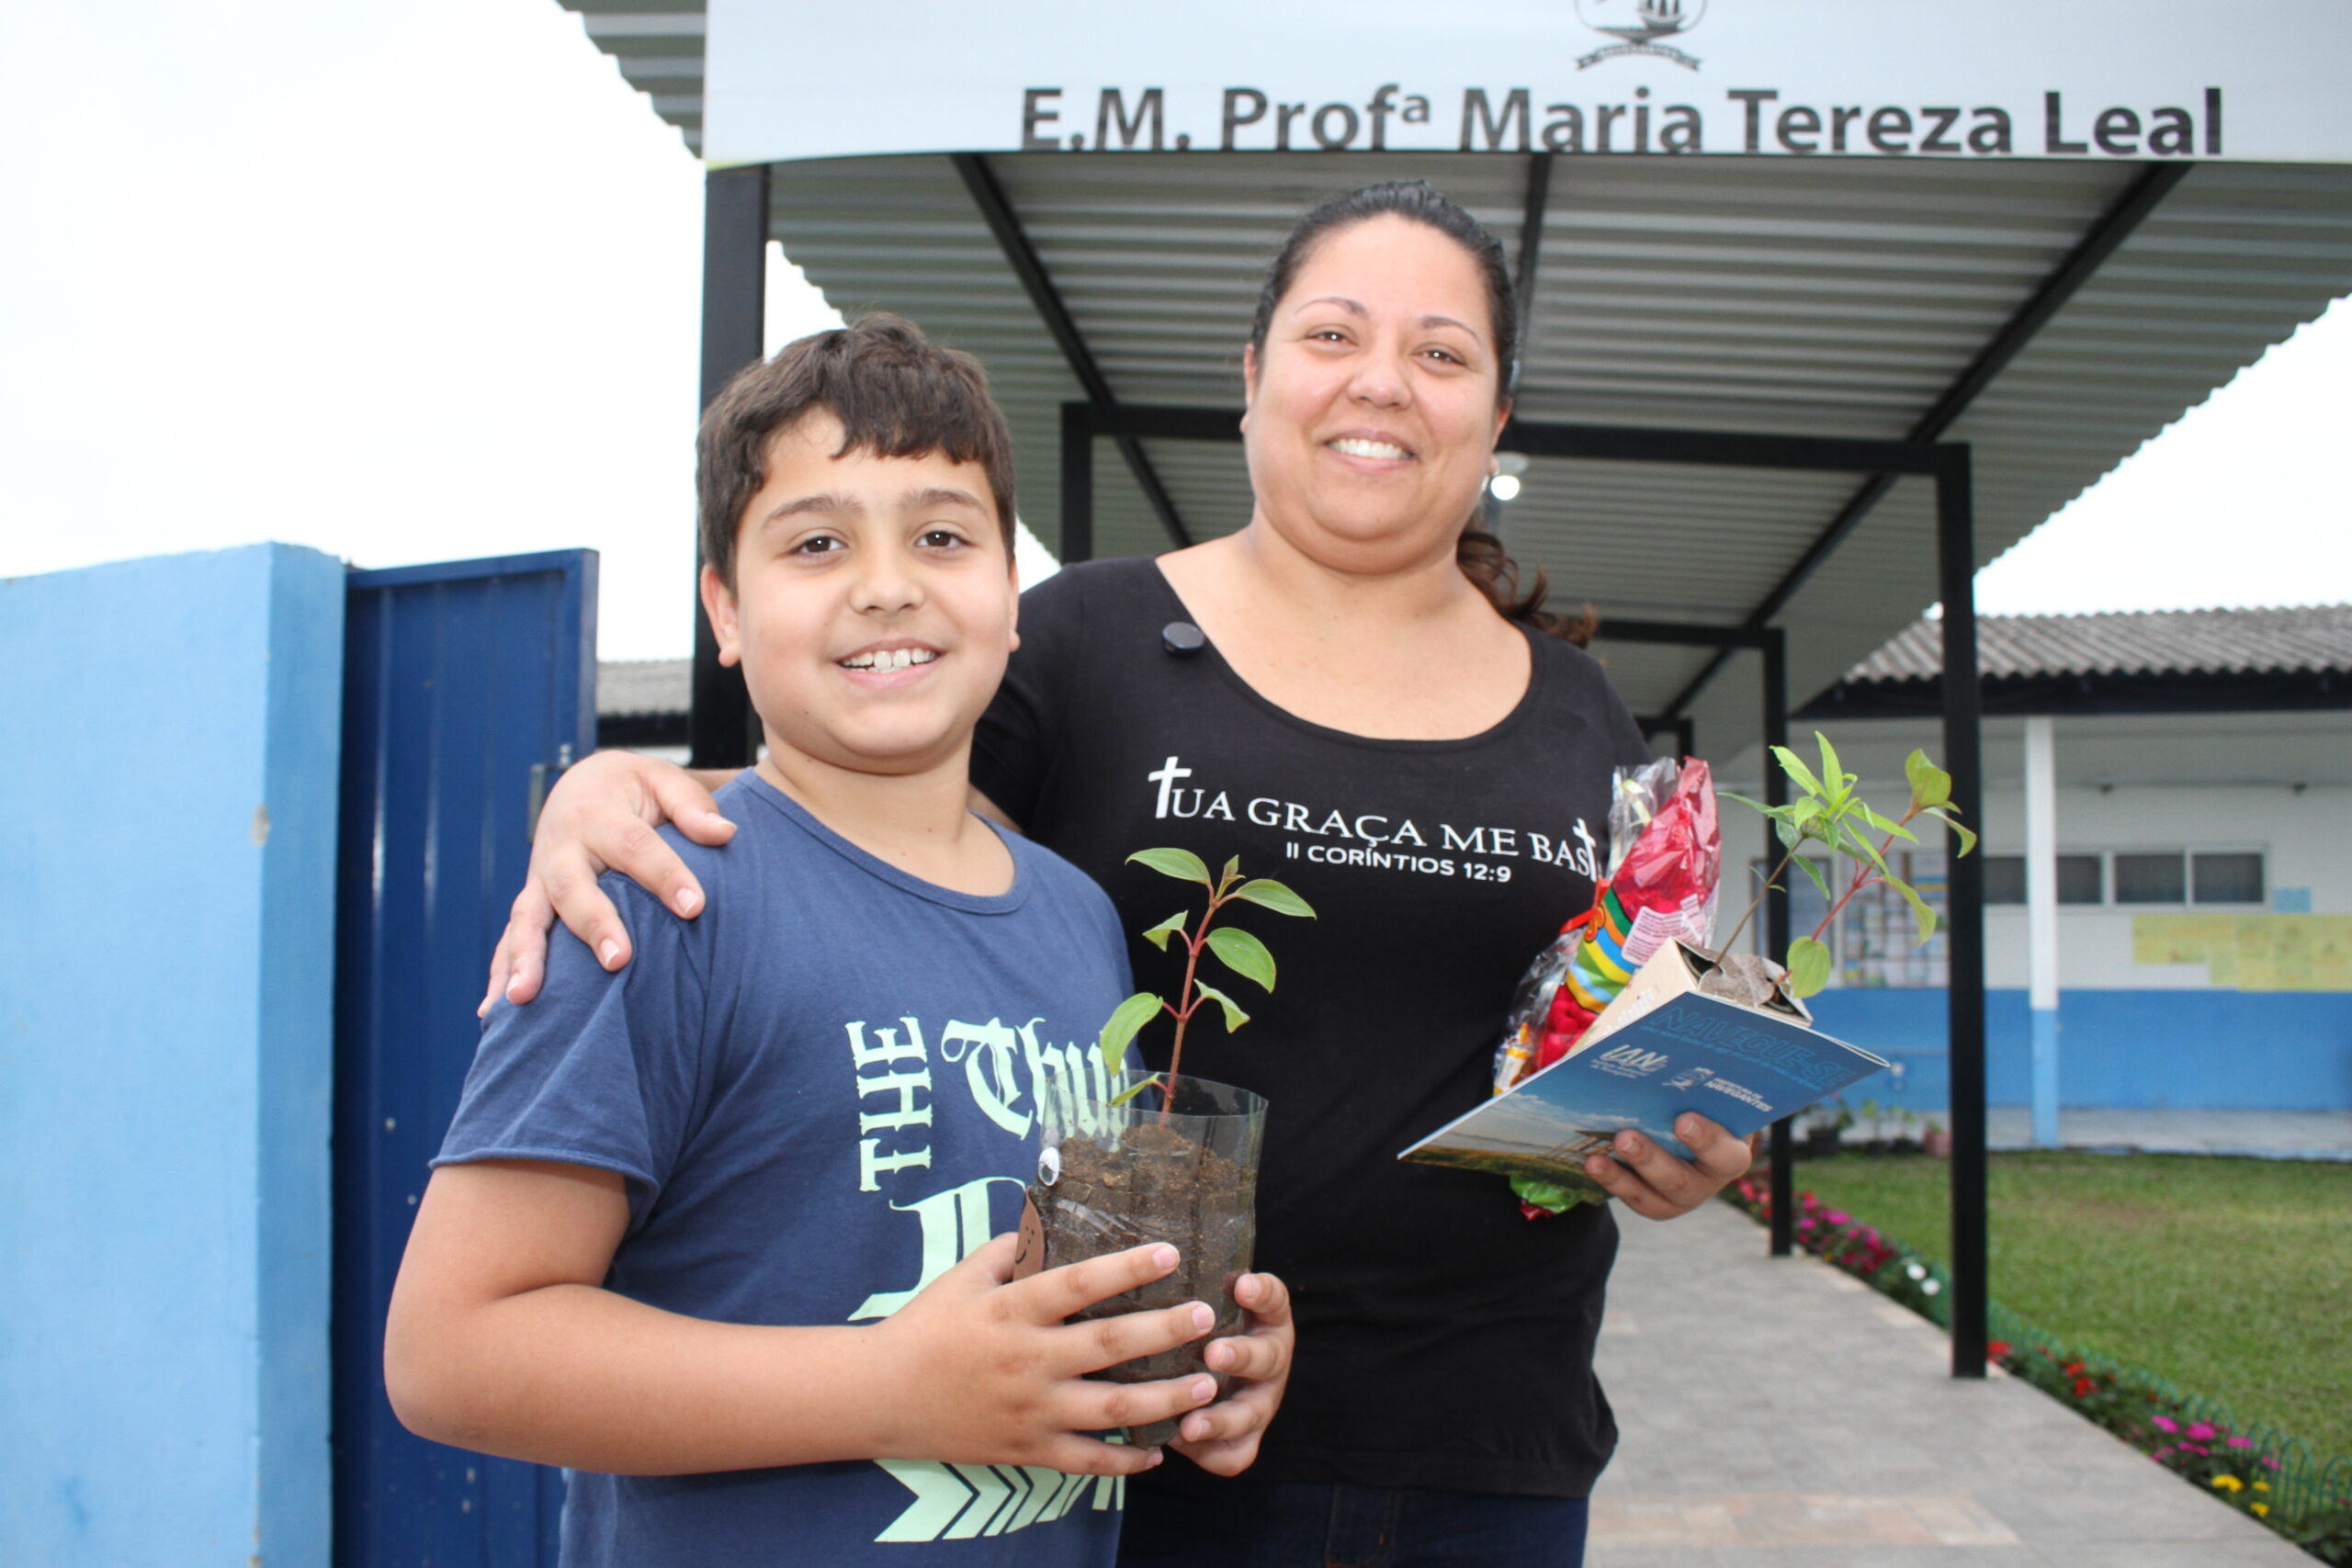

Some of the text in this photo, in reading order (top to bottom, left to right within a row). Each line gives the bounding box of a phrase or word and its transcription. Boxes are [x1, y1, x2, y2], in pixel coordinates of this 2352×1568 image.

[1022, 85, 2222, 155] E.M. Profª Maria Tereza Leal
[1248, 797, 1427, 848] GRAÇA
[1441, 823, 1520, 856] ME
[1527, 818, 1598, 883] BAST
[1286, 841, 1511, 883] II CORÍNTIOS 12:9
[844, 1016, 933, 1192] THE
